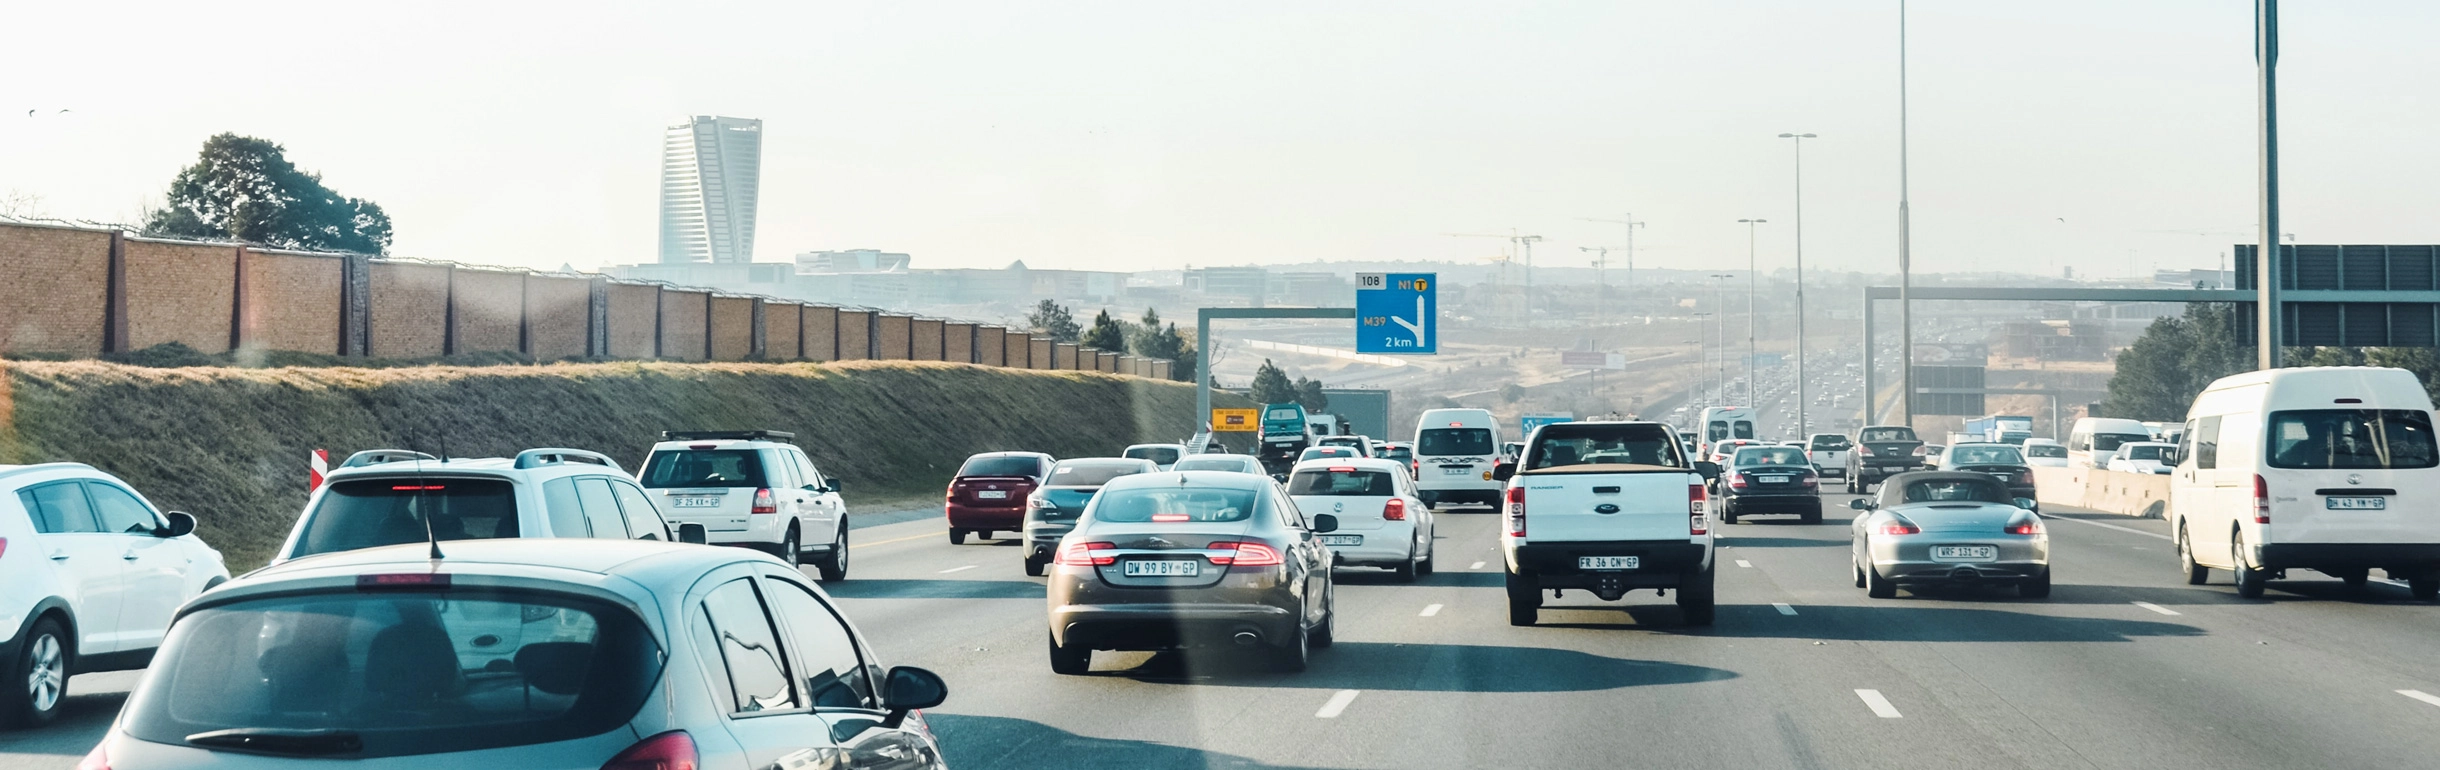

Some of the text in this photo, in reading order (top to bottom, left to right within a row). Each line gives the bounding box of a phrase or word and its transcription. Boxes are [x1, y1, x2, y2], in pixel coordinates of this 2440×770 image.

[1362, 276, 1380, 286] 108
[1398, 280, 1426, 291] N1 T
[1364, 316, 1386, 327] M39
[1385, 337, 1412, 348] 2 km
[2373, 498, 2382, 507] GP
[1941, 547, 1989, 556] WRF 131 GP
[1580, 558, 1637, 567] FR 36 CN GP
[1128, 562, 1140, 574] DW
[1144, 562, 1157, 574] 99
[1161, 562, 1174, 574] BY
[1182, 562, 1195, 574] GP
